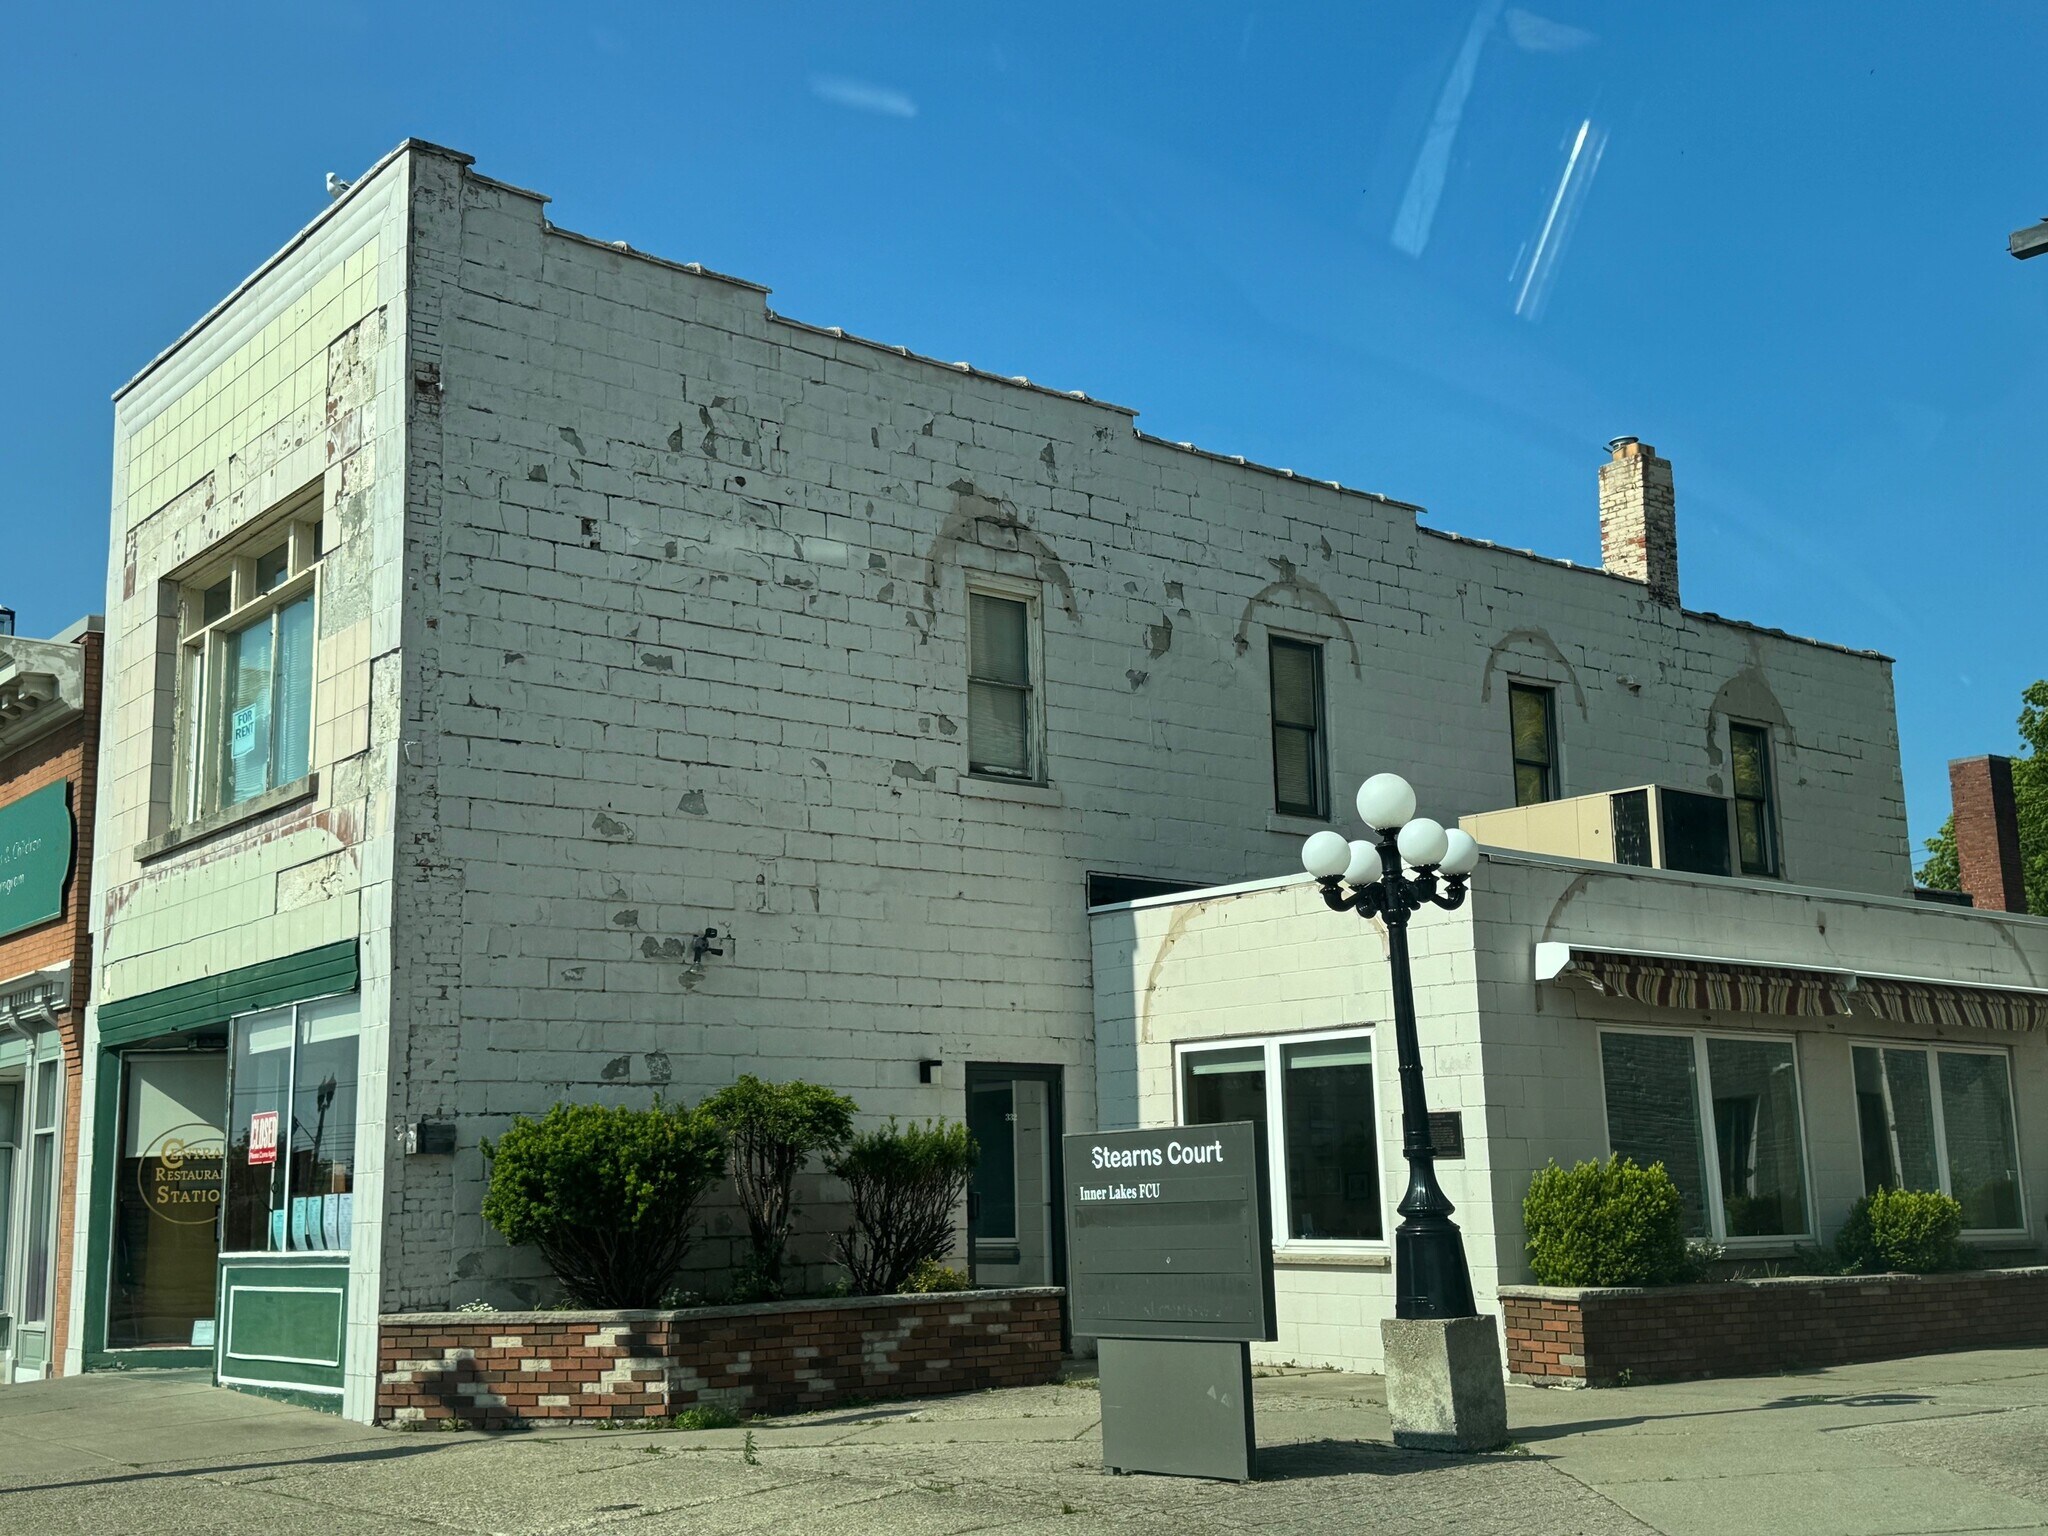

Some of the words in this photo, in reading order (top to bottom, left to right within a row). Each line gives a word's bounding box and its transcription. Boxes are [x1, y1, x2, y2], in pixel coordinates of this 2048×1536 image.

[237, 710, 253, 726] FOR
[235, 721, 254, 740] RENT
[250, 1116, 277, 1150] CLOSED
[161, 1138, 224, 1169] CENTRA
[1091, 1146, 1163, 1169] Stearns
[1167, 1140, 1224, 1165] Court
[155, 1167, 224, 1182] RESTAURA
[156, 1185, 221, 1204] STATIO
[1079, 1186, 1107, 1201] Inner
[1108, 1184, 1137, 1200] Lakes
[1138, 1183, 1161, 1199] FCU
